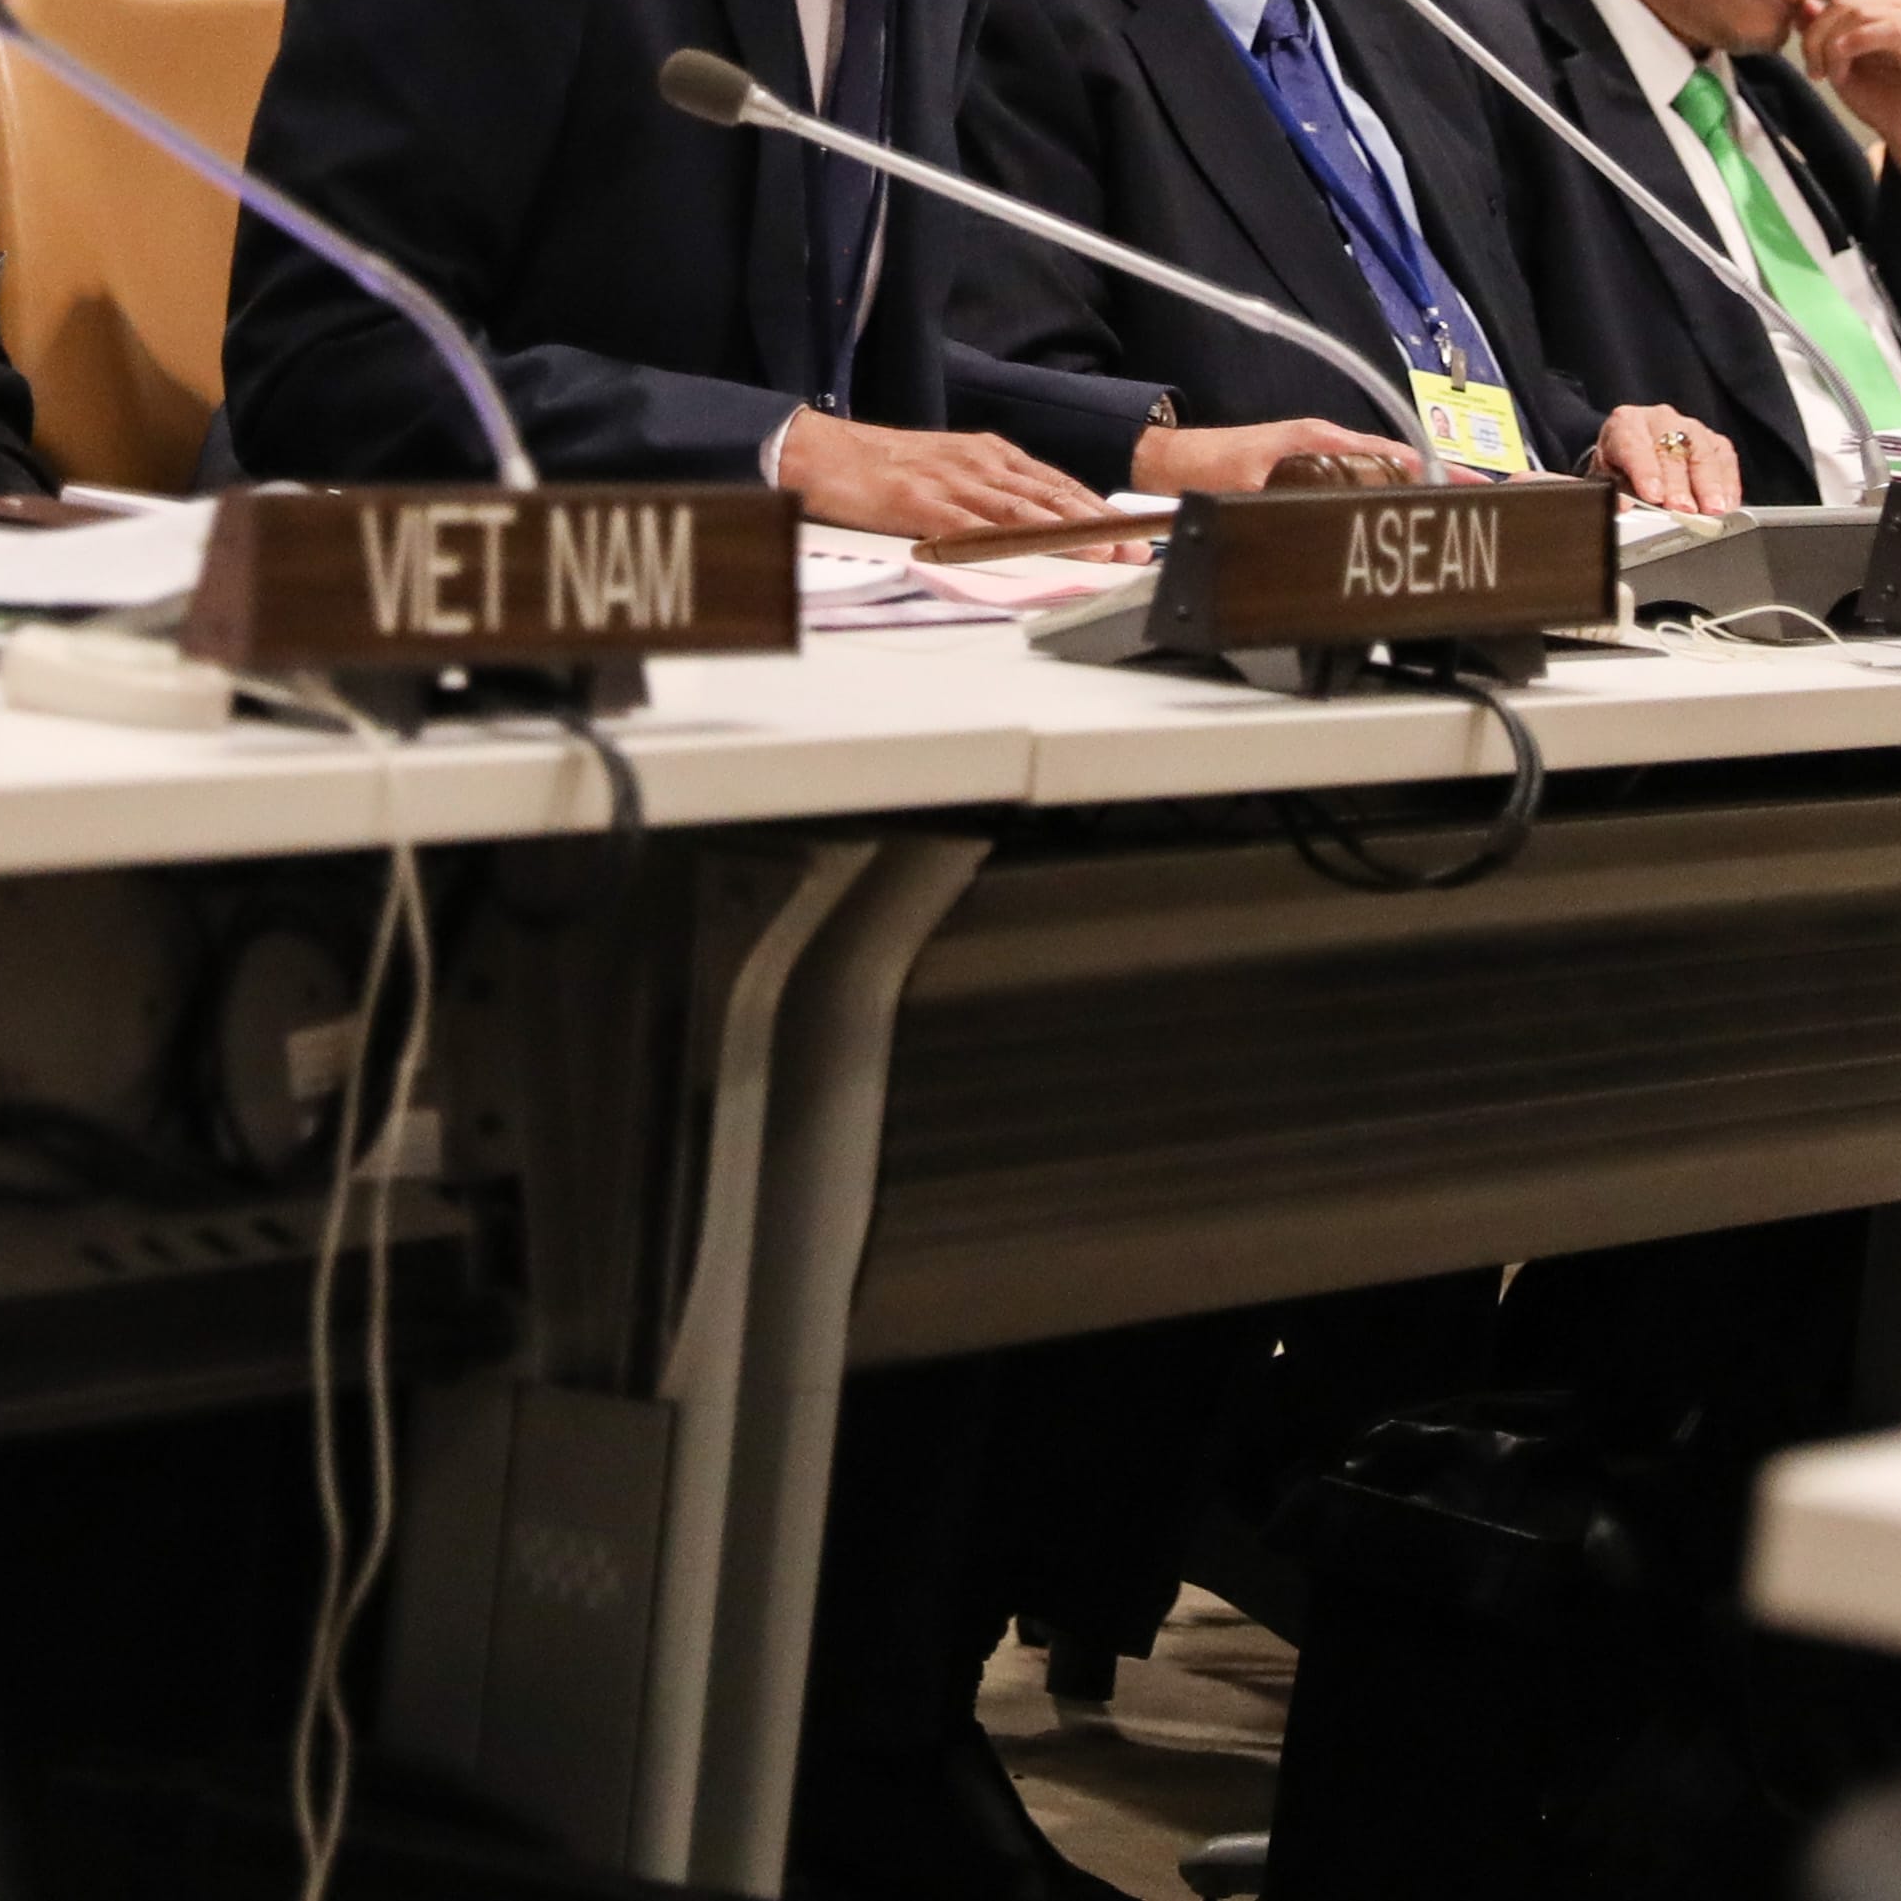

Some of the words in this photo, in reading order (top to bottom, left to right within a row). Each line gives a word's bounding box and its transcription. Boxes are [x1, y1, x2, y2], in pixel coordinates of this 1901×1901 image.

[358, 504, 517, 637] VIET
[546, 504, 694, 632] NAM
[1342, 506, 1500, 599] ASEAN
